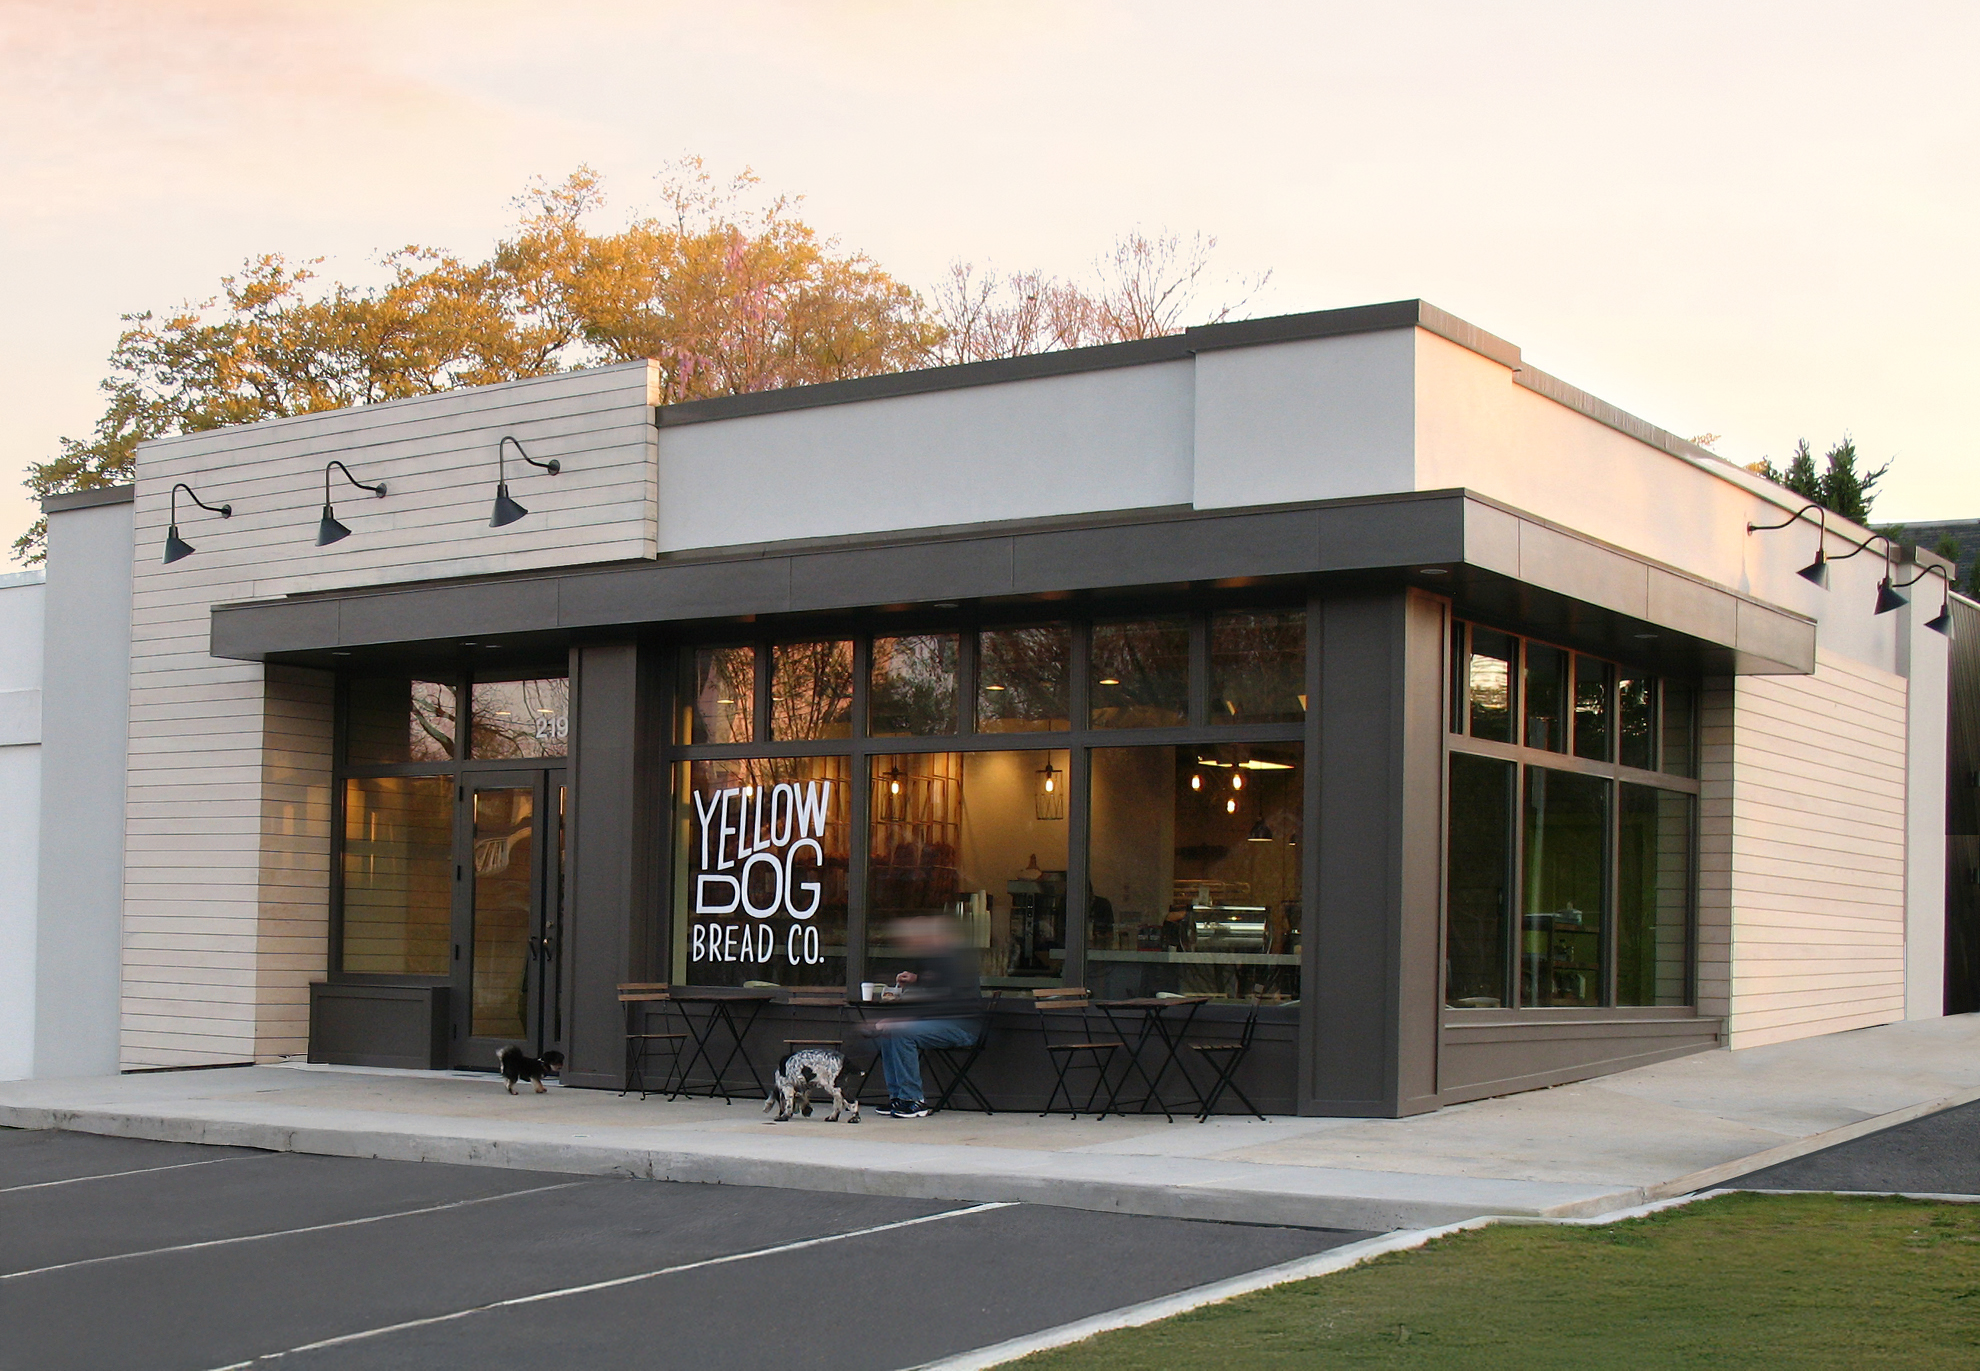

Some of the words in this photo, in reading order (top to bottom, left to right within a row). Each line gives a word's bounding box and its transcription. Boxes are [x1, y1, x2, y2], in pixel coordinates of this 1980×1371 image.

[535, 716, 569, 739] 219
[693, 780, 831, 871] YELLOW
[695, 838, 823, 920] DOG
[692, 922, 774, 964] BREAD
[787, 923, 825, 966] CO.
